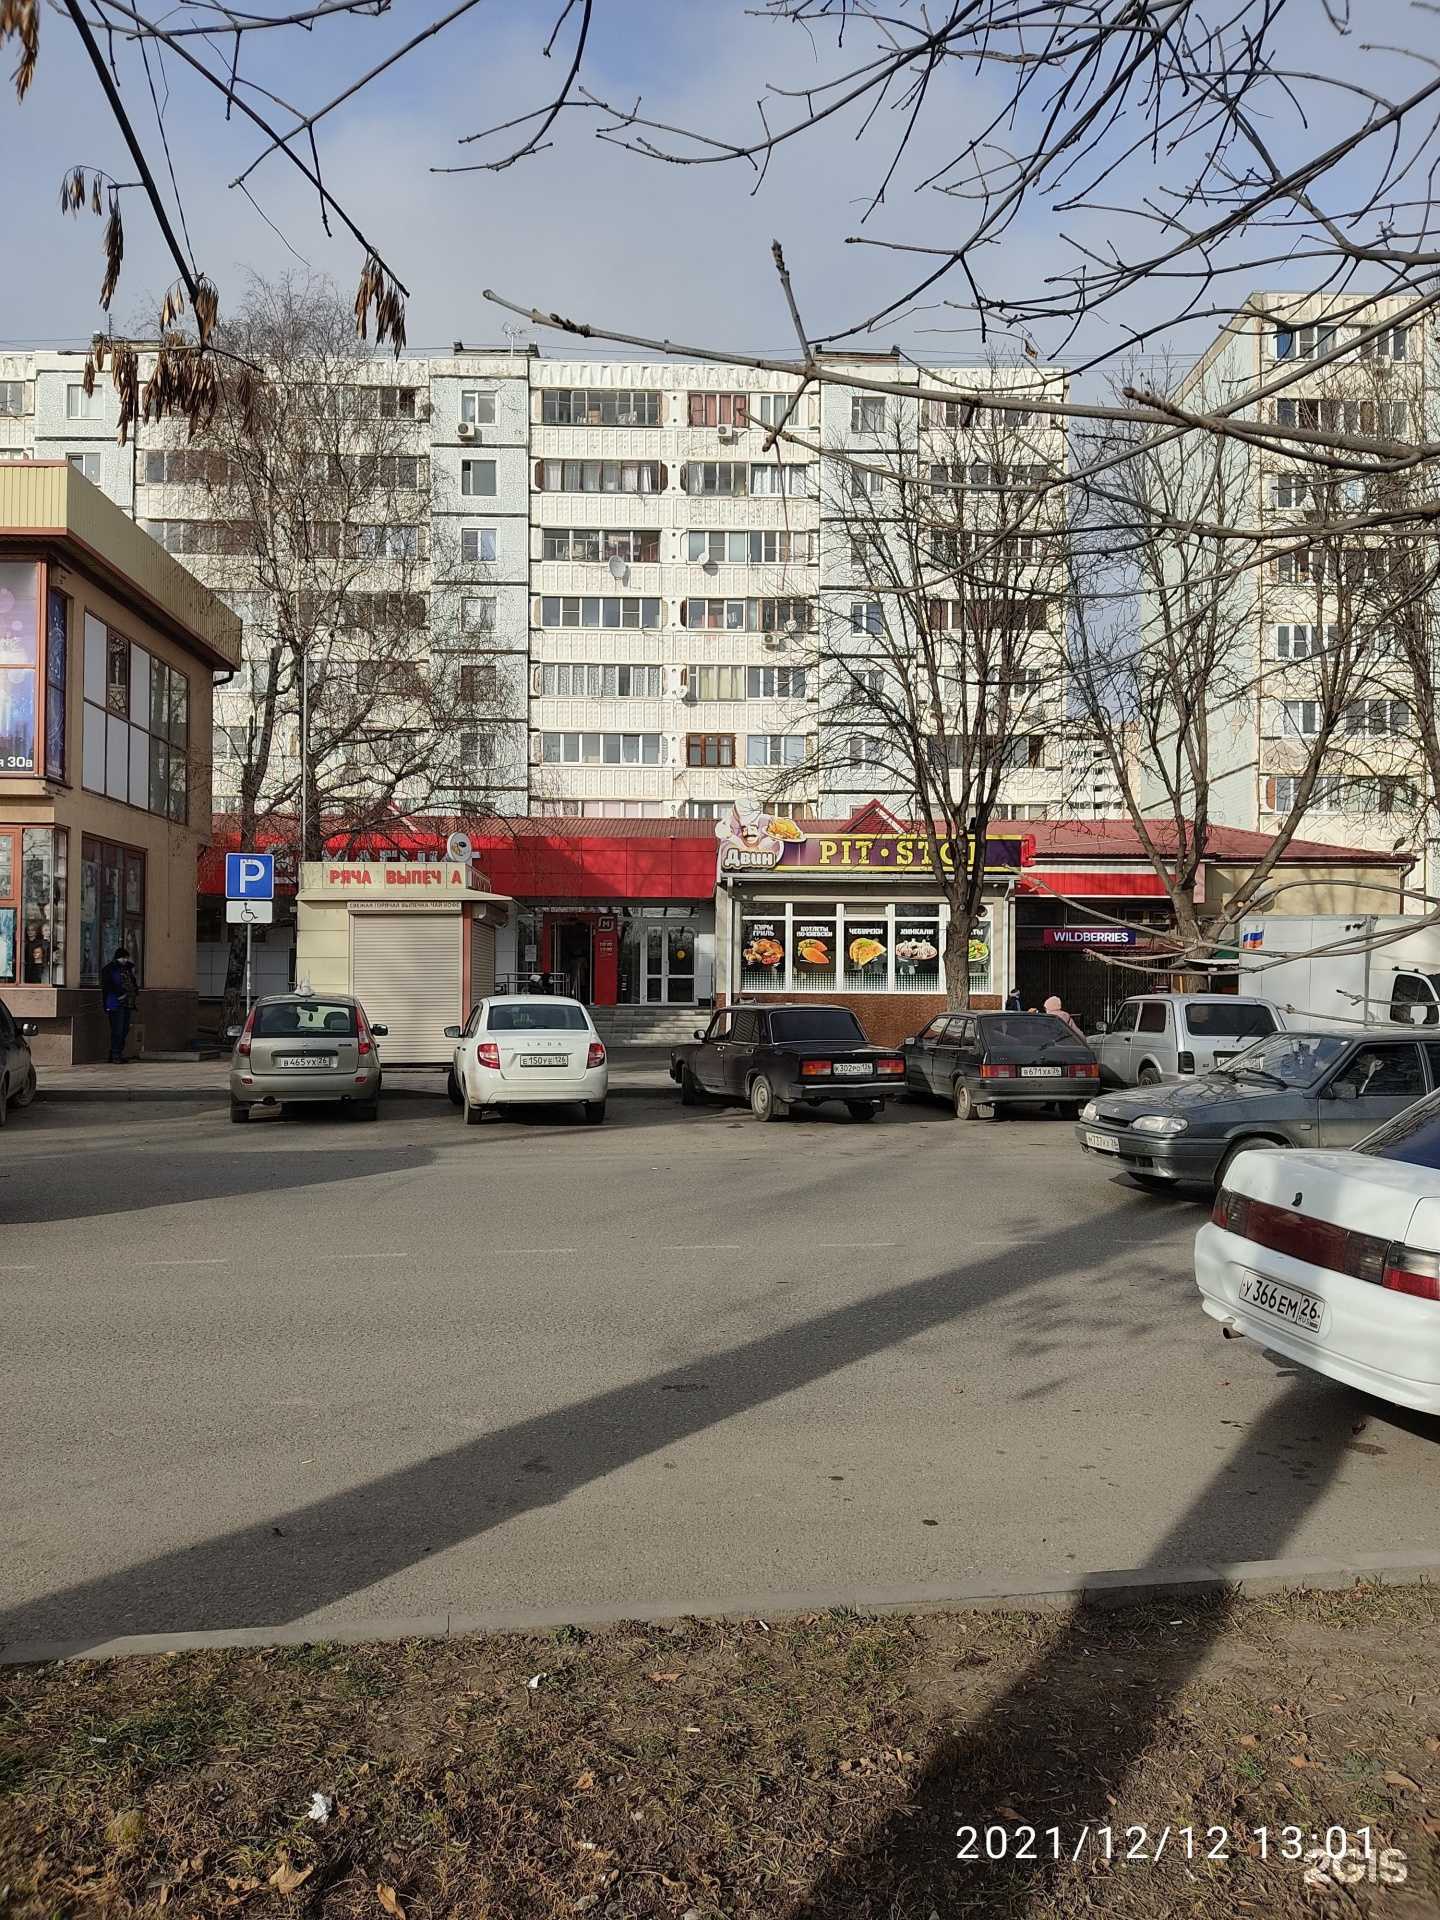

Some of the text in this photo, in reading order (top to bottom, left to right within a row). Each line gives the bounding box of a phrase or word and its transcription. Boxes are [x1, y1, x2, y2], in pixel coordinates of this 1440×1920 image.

[819, 840, 873, 865] PIT
[329, 870, 373, 885] РЯЧА
[385, 870, 441, 885] ВЫПЕЧ
[1053, 931, 1129, 942] WILDBERRIES
